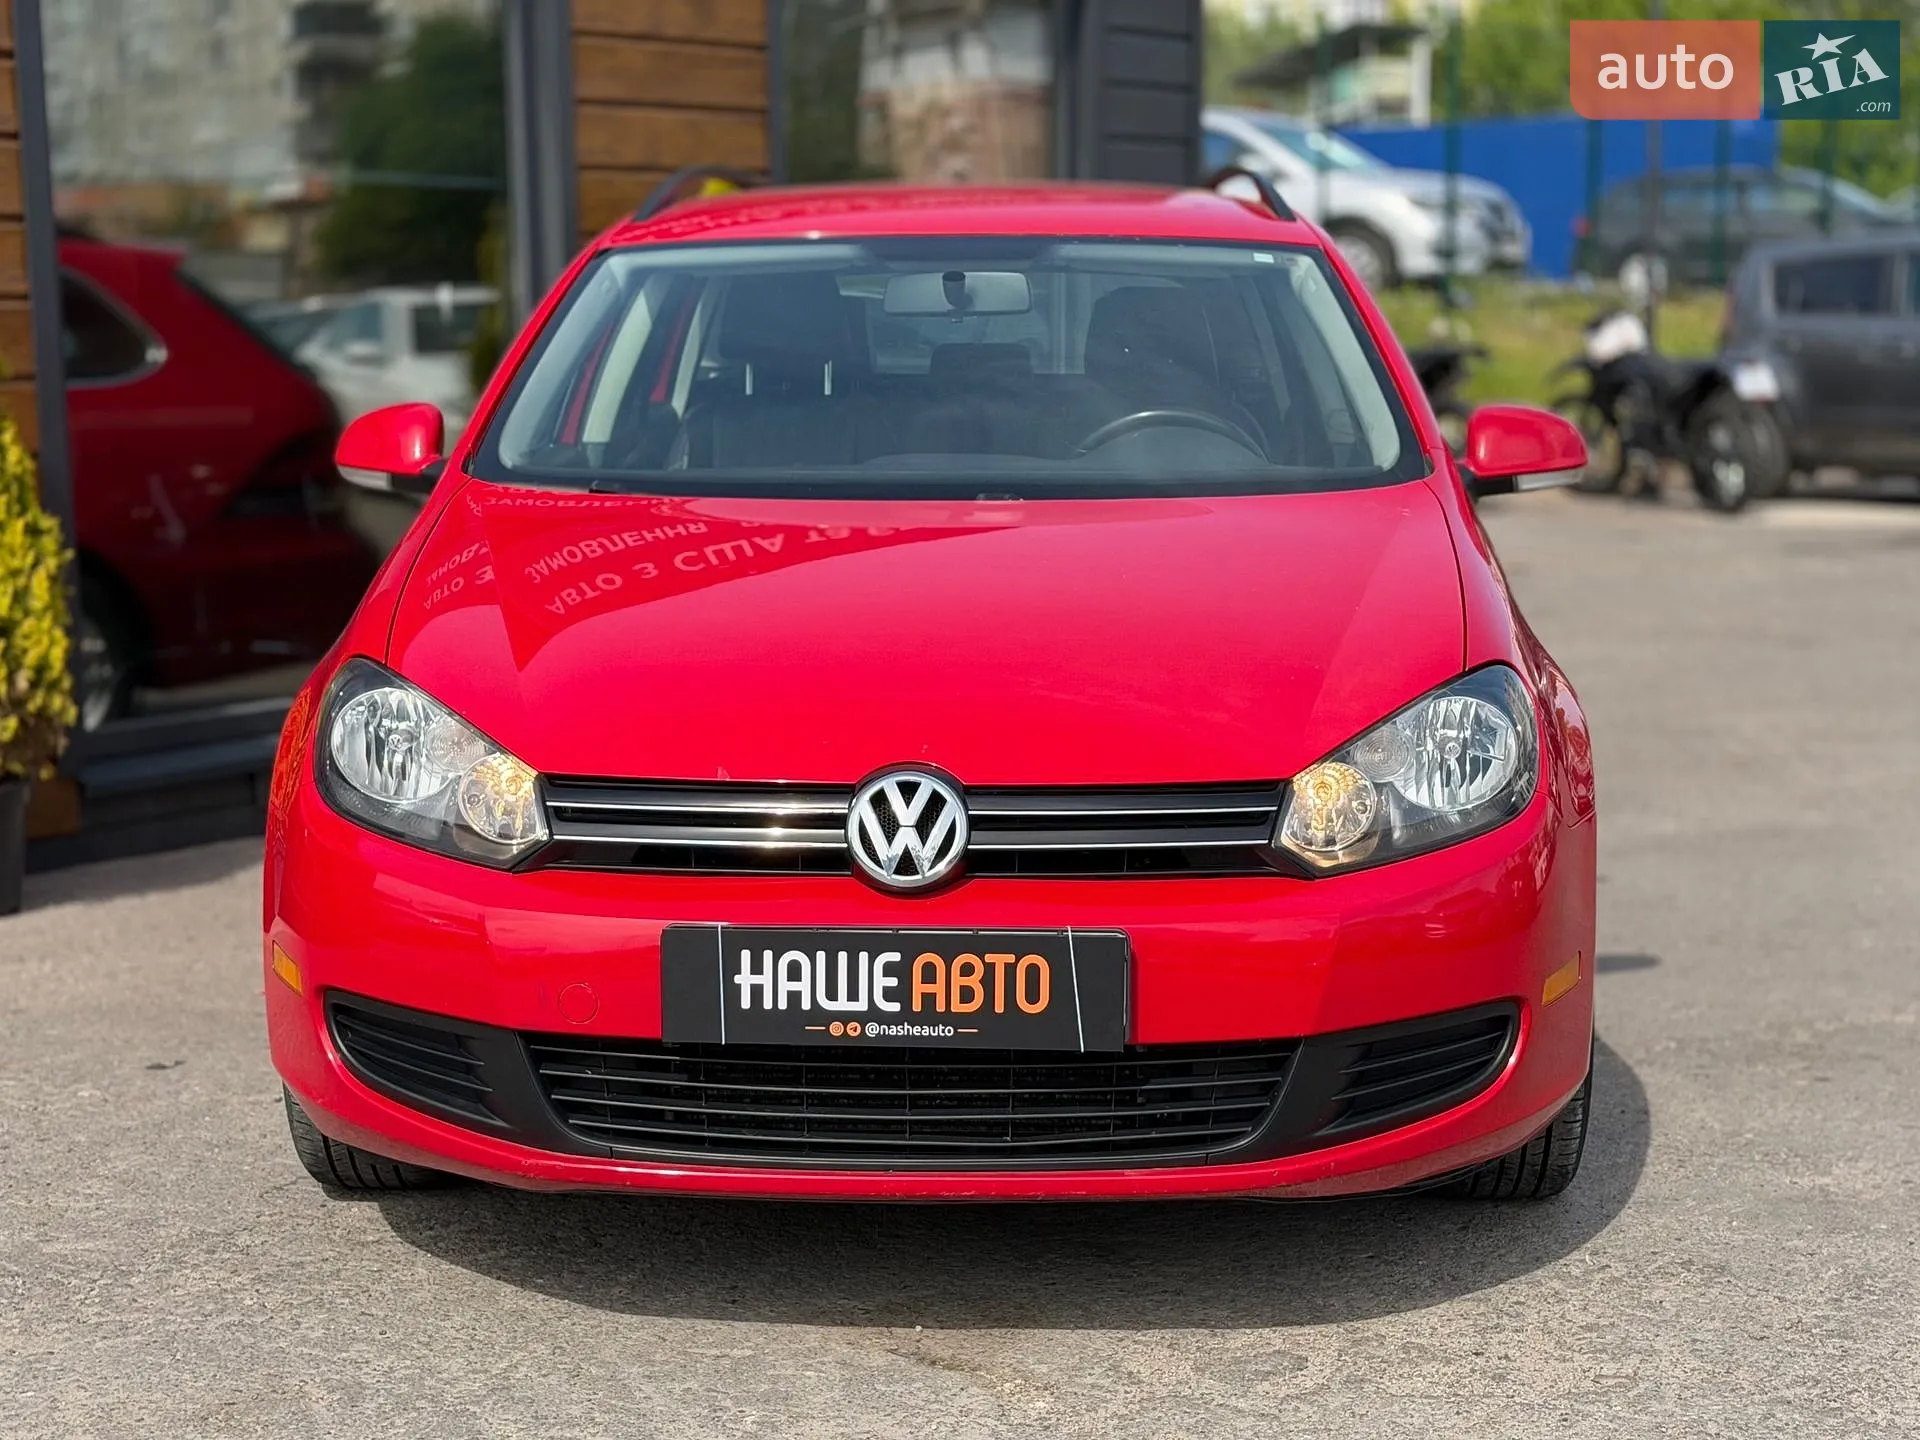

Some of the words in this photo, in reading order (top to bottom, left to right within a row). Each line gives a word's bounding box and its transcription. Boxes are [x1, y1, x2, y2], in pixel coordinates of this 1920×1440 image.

[848, 771, 968, 887] VW
[733, 948, 901, 1013] НАШЕ
[911, 951, 1051, 1015] АВТО
[864, 1021, 955, 1038] @nasheauto
